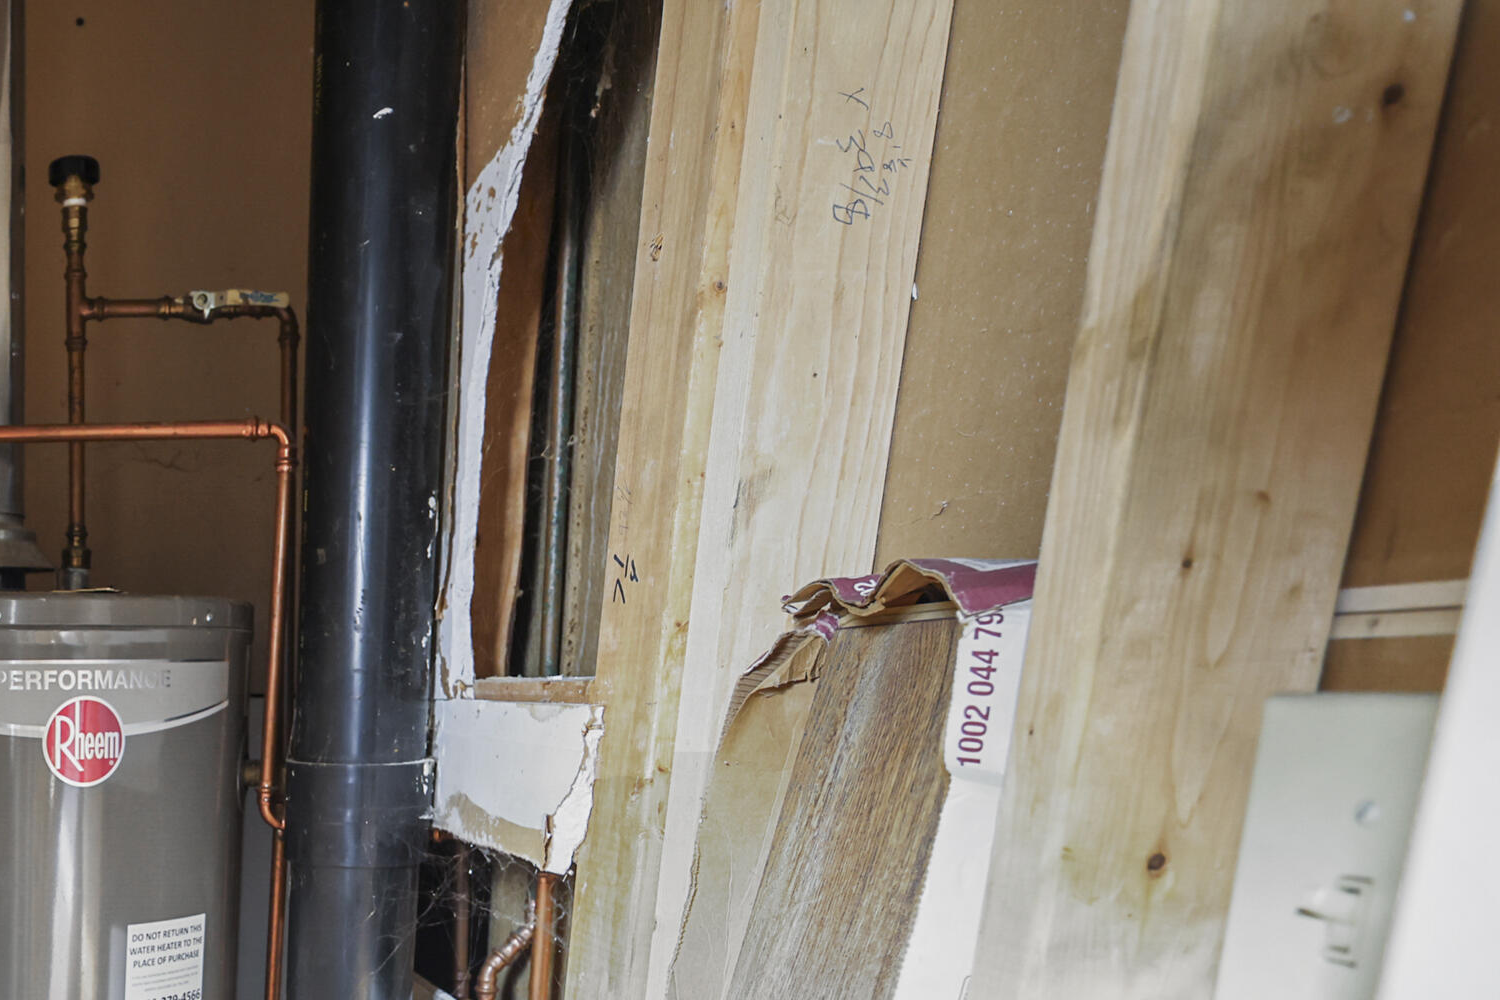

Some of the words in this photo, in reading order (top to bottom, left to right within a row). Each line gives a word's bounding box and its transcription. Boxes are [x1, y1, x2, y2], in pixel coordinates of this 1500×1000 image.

[967, 649, 999, 696] 044
[54, 700, 120, 772] Rheem
[957, 705, 991, 766] 1002
[129, 945, 155, 956] WATER
[157, 940, 182, 952] HEATER
[184, 938, 192, 947] TO
[193, 936, 202, 945] THE
[132, 933, 143, 943] DO
[146, 931, 161, 941] NOT
[163, 926, 189, 938] RETURN
[190, 924, 202, 934] THIS
[133, 956, 155, 968] PLACE
[157, 955, 167, 965] OF
[168, 949, 199, 963] PURCHASE
